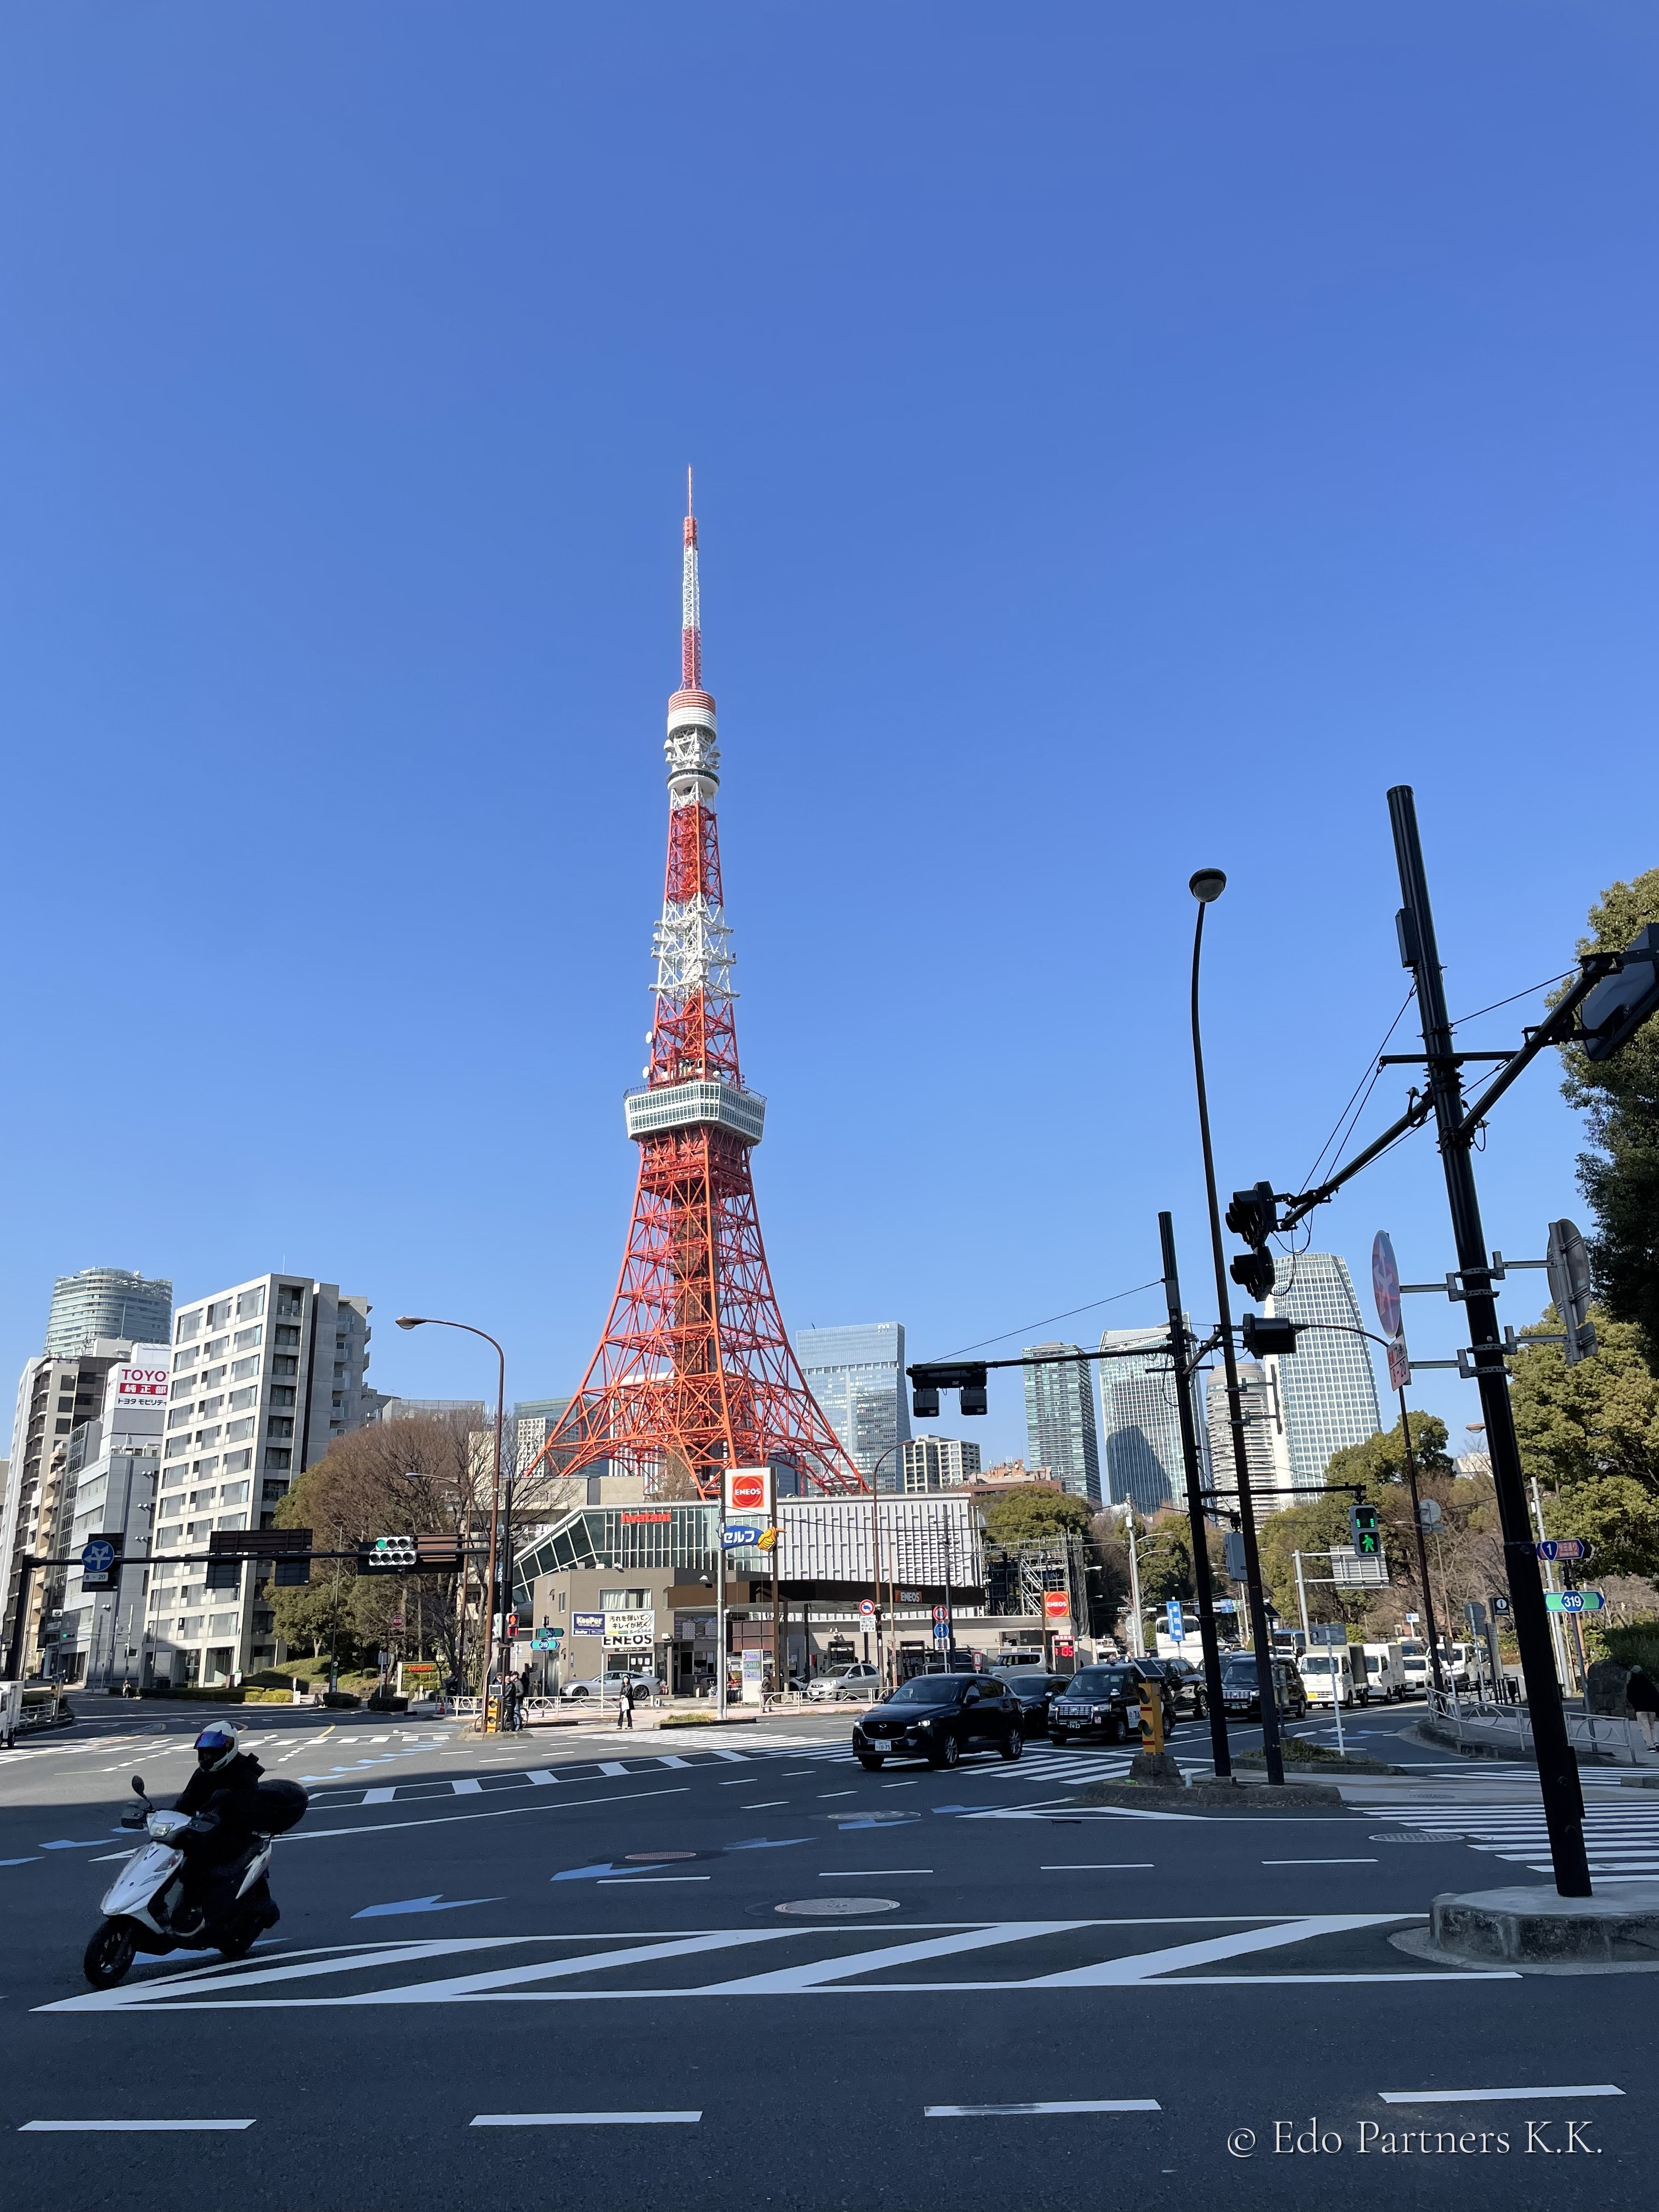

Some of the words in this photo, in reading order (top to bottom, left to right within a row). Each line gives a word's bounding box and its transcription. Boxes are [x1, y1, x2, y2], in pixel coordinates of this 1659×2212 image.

[121, 1369, 170, 1382] TOYO
[734, 1487, 761, 1496] ENEOS
[621, 1511, 671, 1523] Iwatani
[724, 1530, 755, 1544] セルフ
[1547, 1543, 1552, 1555] 1
[900, 1592, 920, 1602] ENEOS
[1564, 1595, 1582, 1607] 319
[603, 1634, 652, 1646] ENEOS
